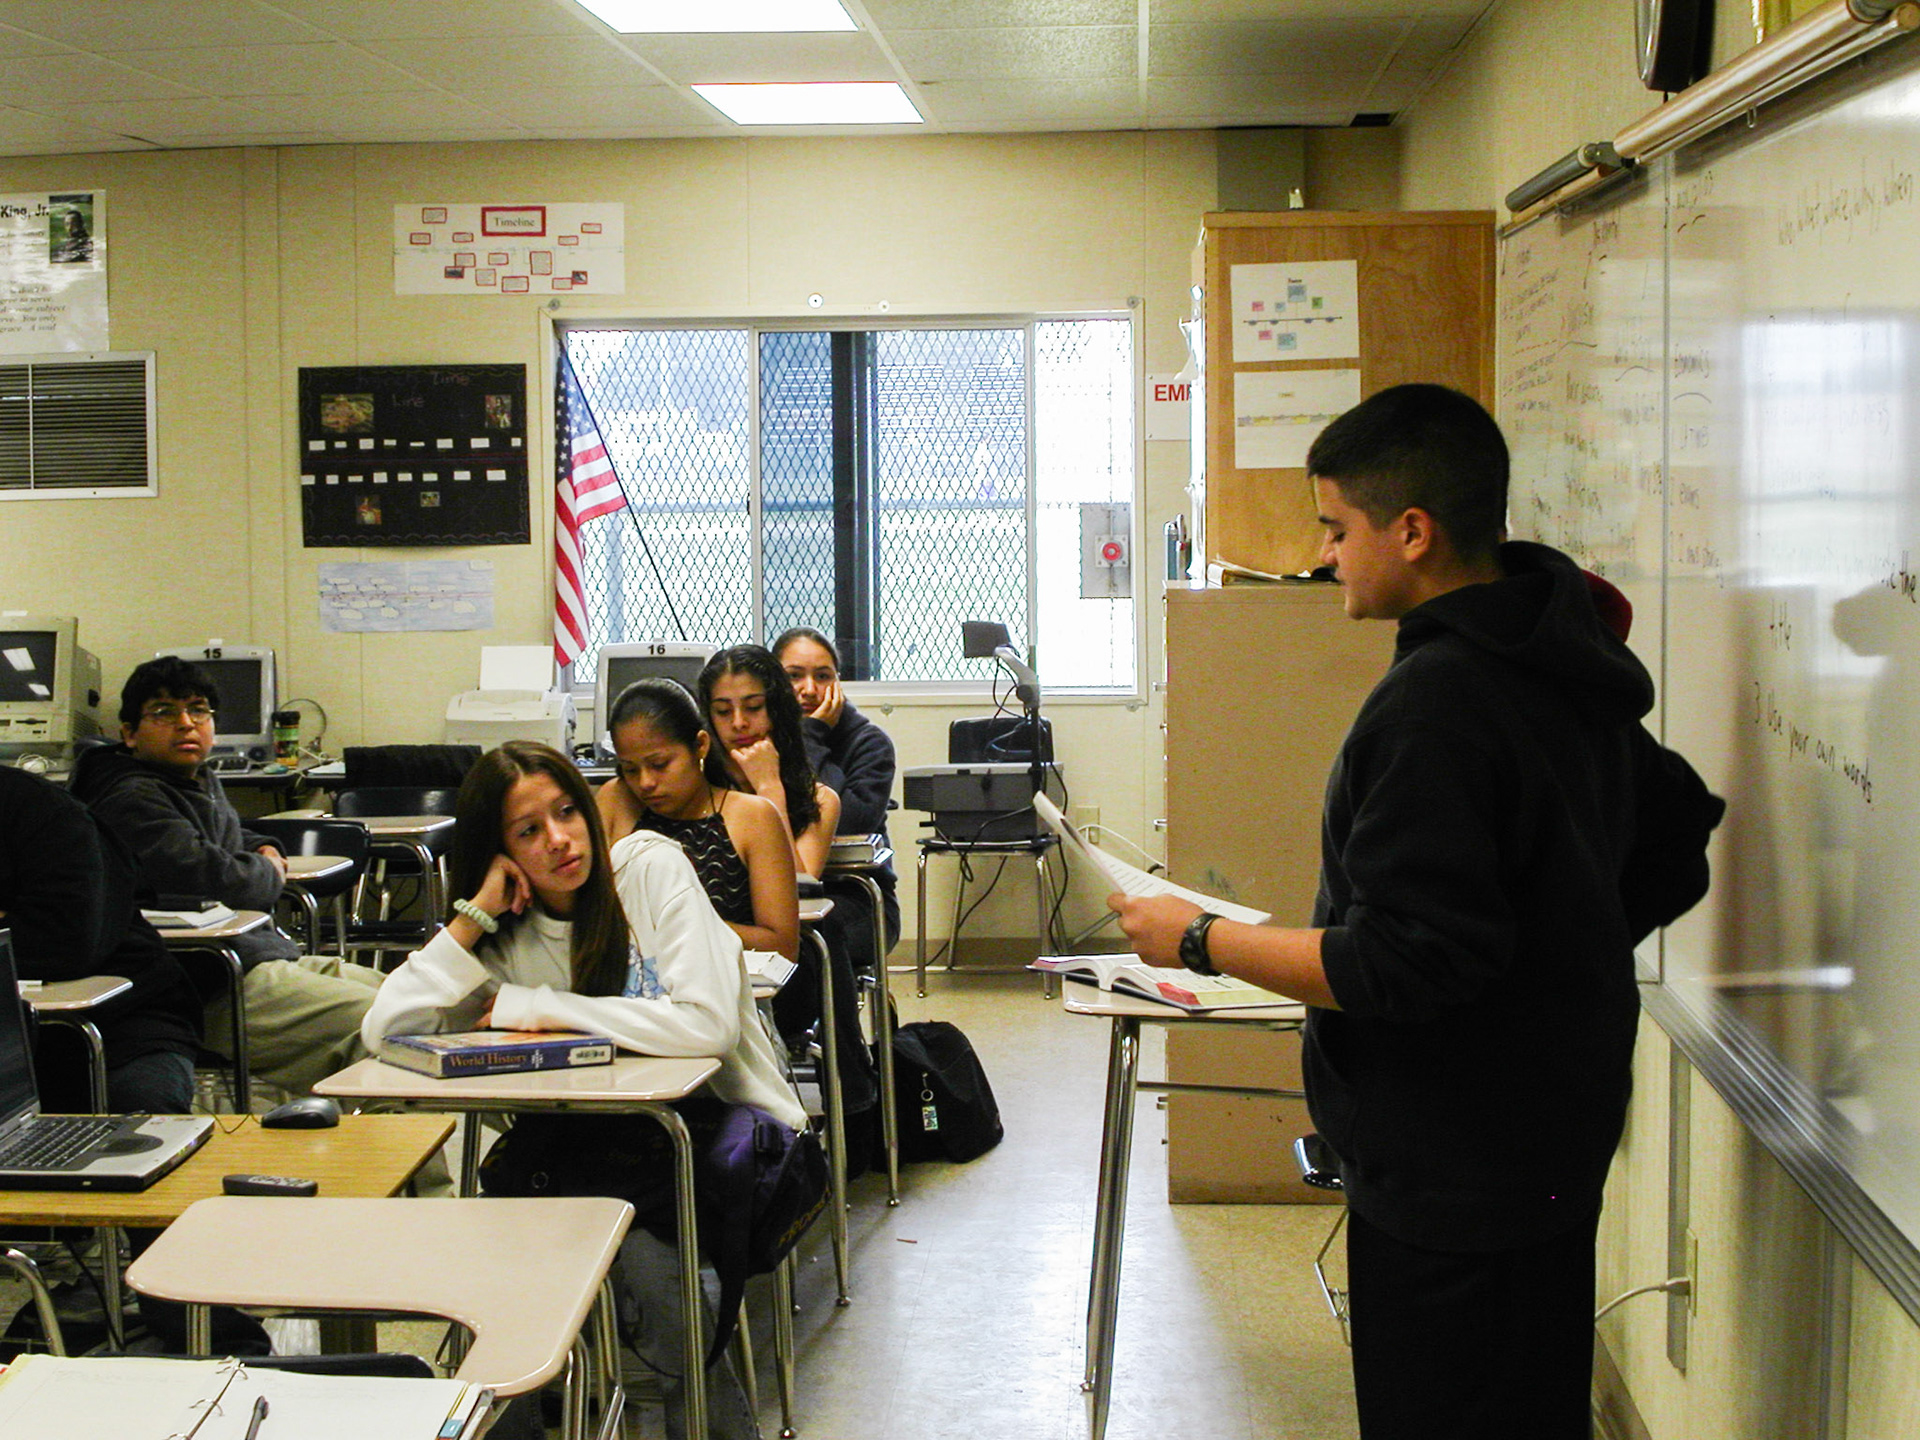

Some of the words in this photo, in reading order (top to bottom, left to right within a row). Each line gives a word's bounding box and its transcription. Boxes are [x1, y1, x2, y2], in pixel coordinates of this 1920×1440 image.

[1, 205, 31, 220] King,
[35, 203, 50, 216] Jr.
[493, 216, 535, 227] Timeline
[203, 648, 222, 659] 15
[648, 644, 666, 655] 16
[1816, 739, 1835, 772] own
[449, 1053, 485, 1068] World
[487, 1051, 527, 1065] History
